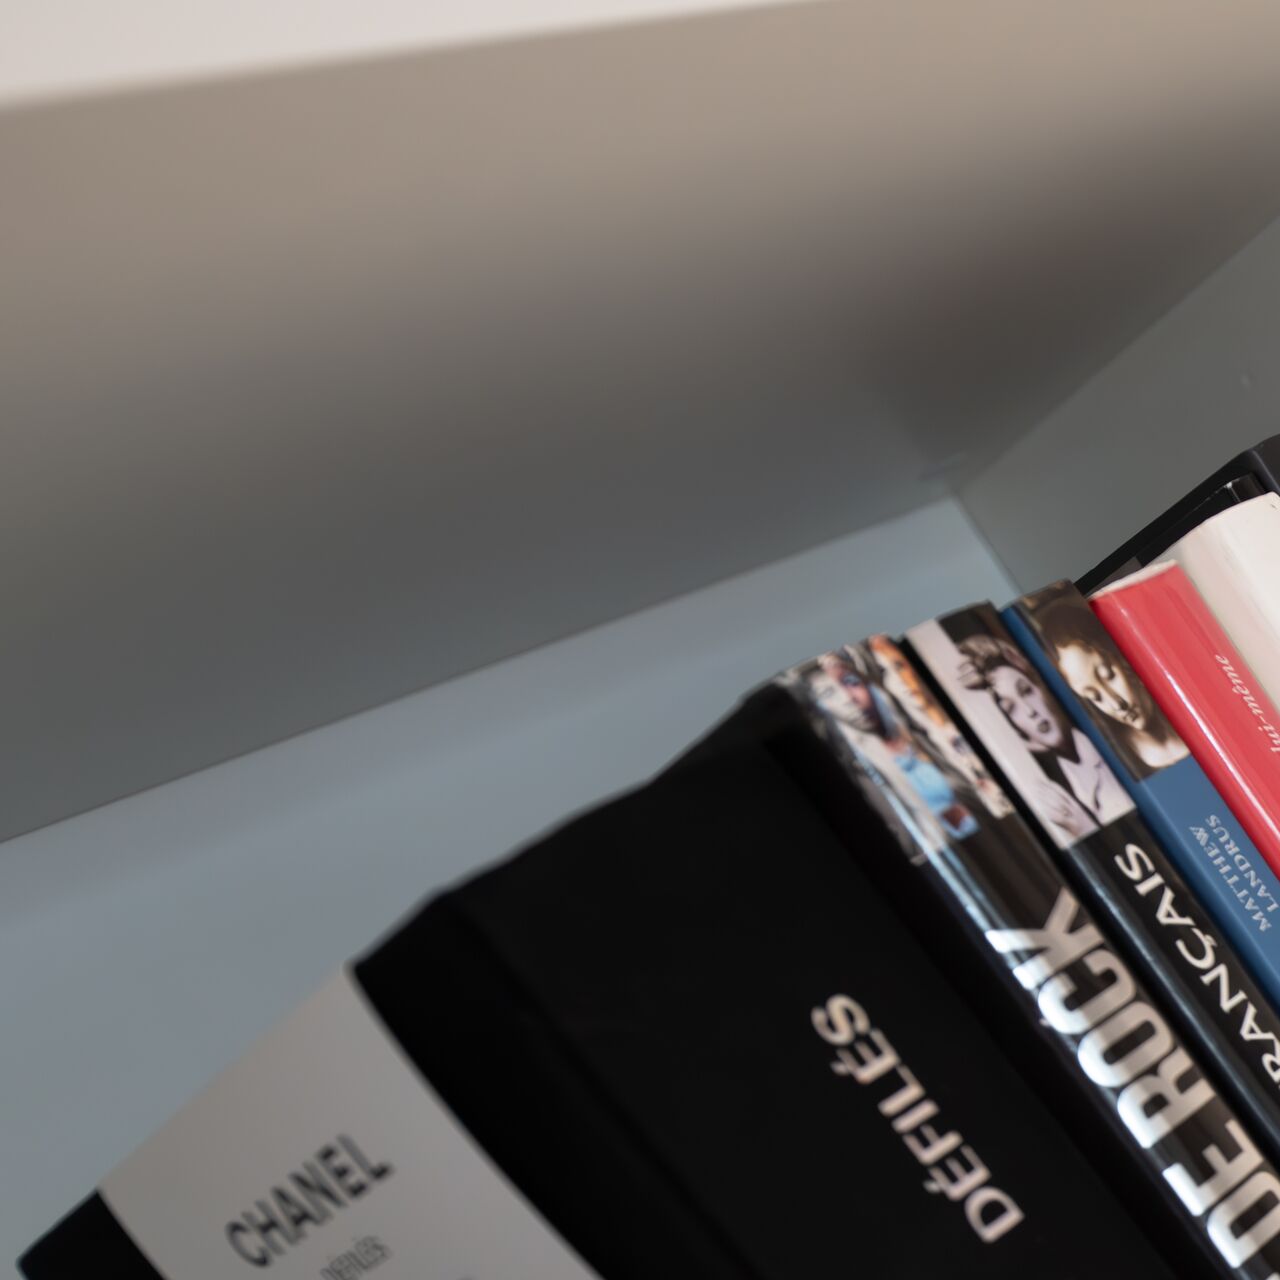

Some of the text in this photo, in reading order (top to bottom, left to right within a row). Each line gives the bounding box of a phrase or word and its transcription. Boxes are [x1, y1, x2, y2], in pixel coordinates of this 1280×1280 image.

[1188, 823, 1273, 933] MATTHEW
[1204, 813, 1280, 913] LANDRUS
[982, 885, 1217, 1152] ROCK
[808, 991, 1025, 1246] DÉFILÉS
[222, 1133, 393, 1269] CHANEL
